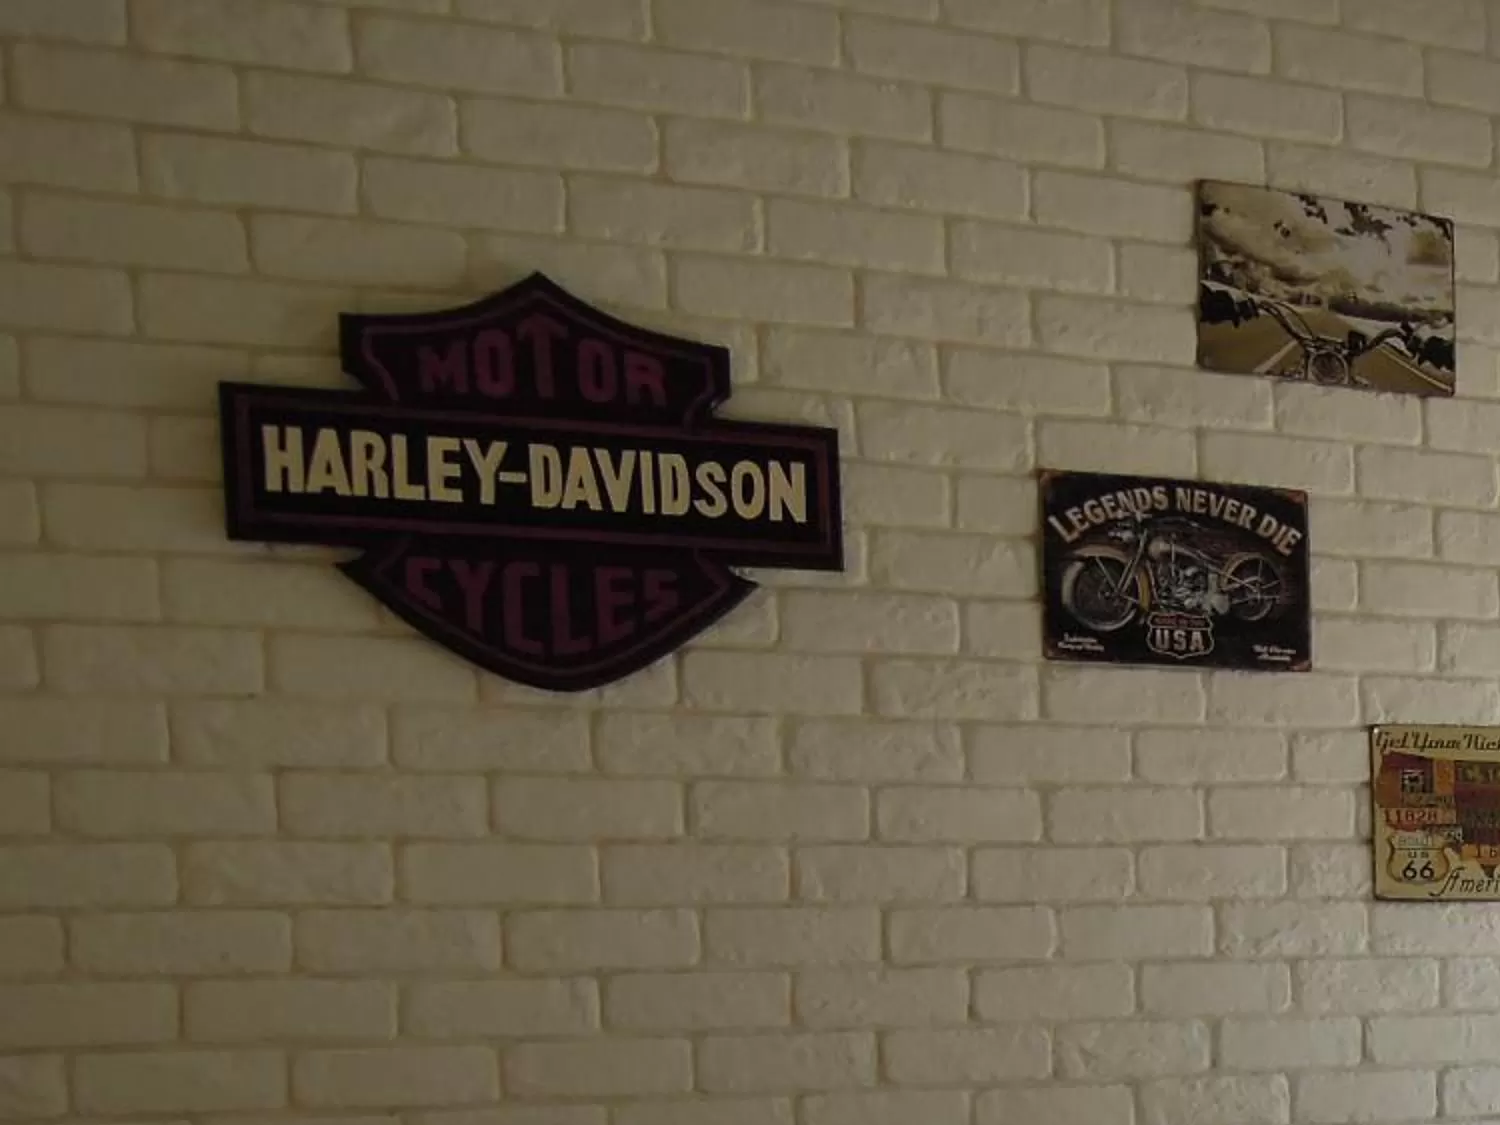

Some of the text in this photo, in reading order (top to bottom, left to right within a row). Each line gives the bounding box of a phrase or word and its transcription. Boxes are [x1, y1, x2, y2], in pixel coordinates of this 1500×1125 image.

[416, 312, 671, 407] MOTOR
[261, 424, 808, 525] HARLEY-DAVIDSON
[1047, 485, 1304, 556] LEGENDS NEVER DIE
[404, 555, 680, 658] CYCLES
[1154, 629, 1205, 652] USA
[1402, 859, 1435, 880] 66
